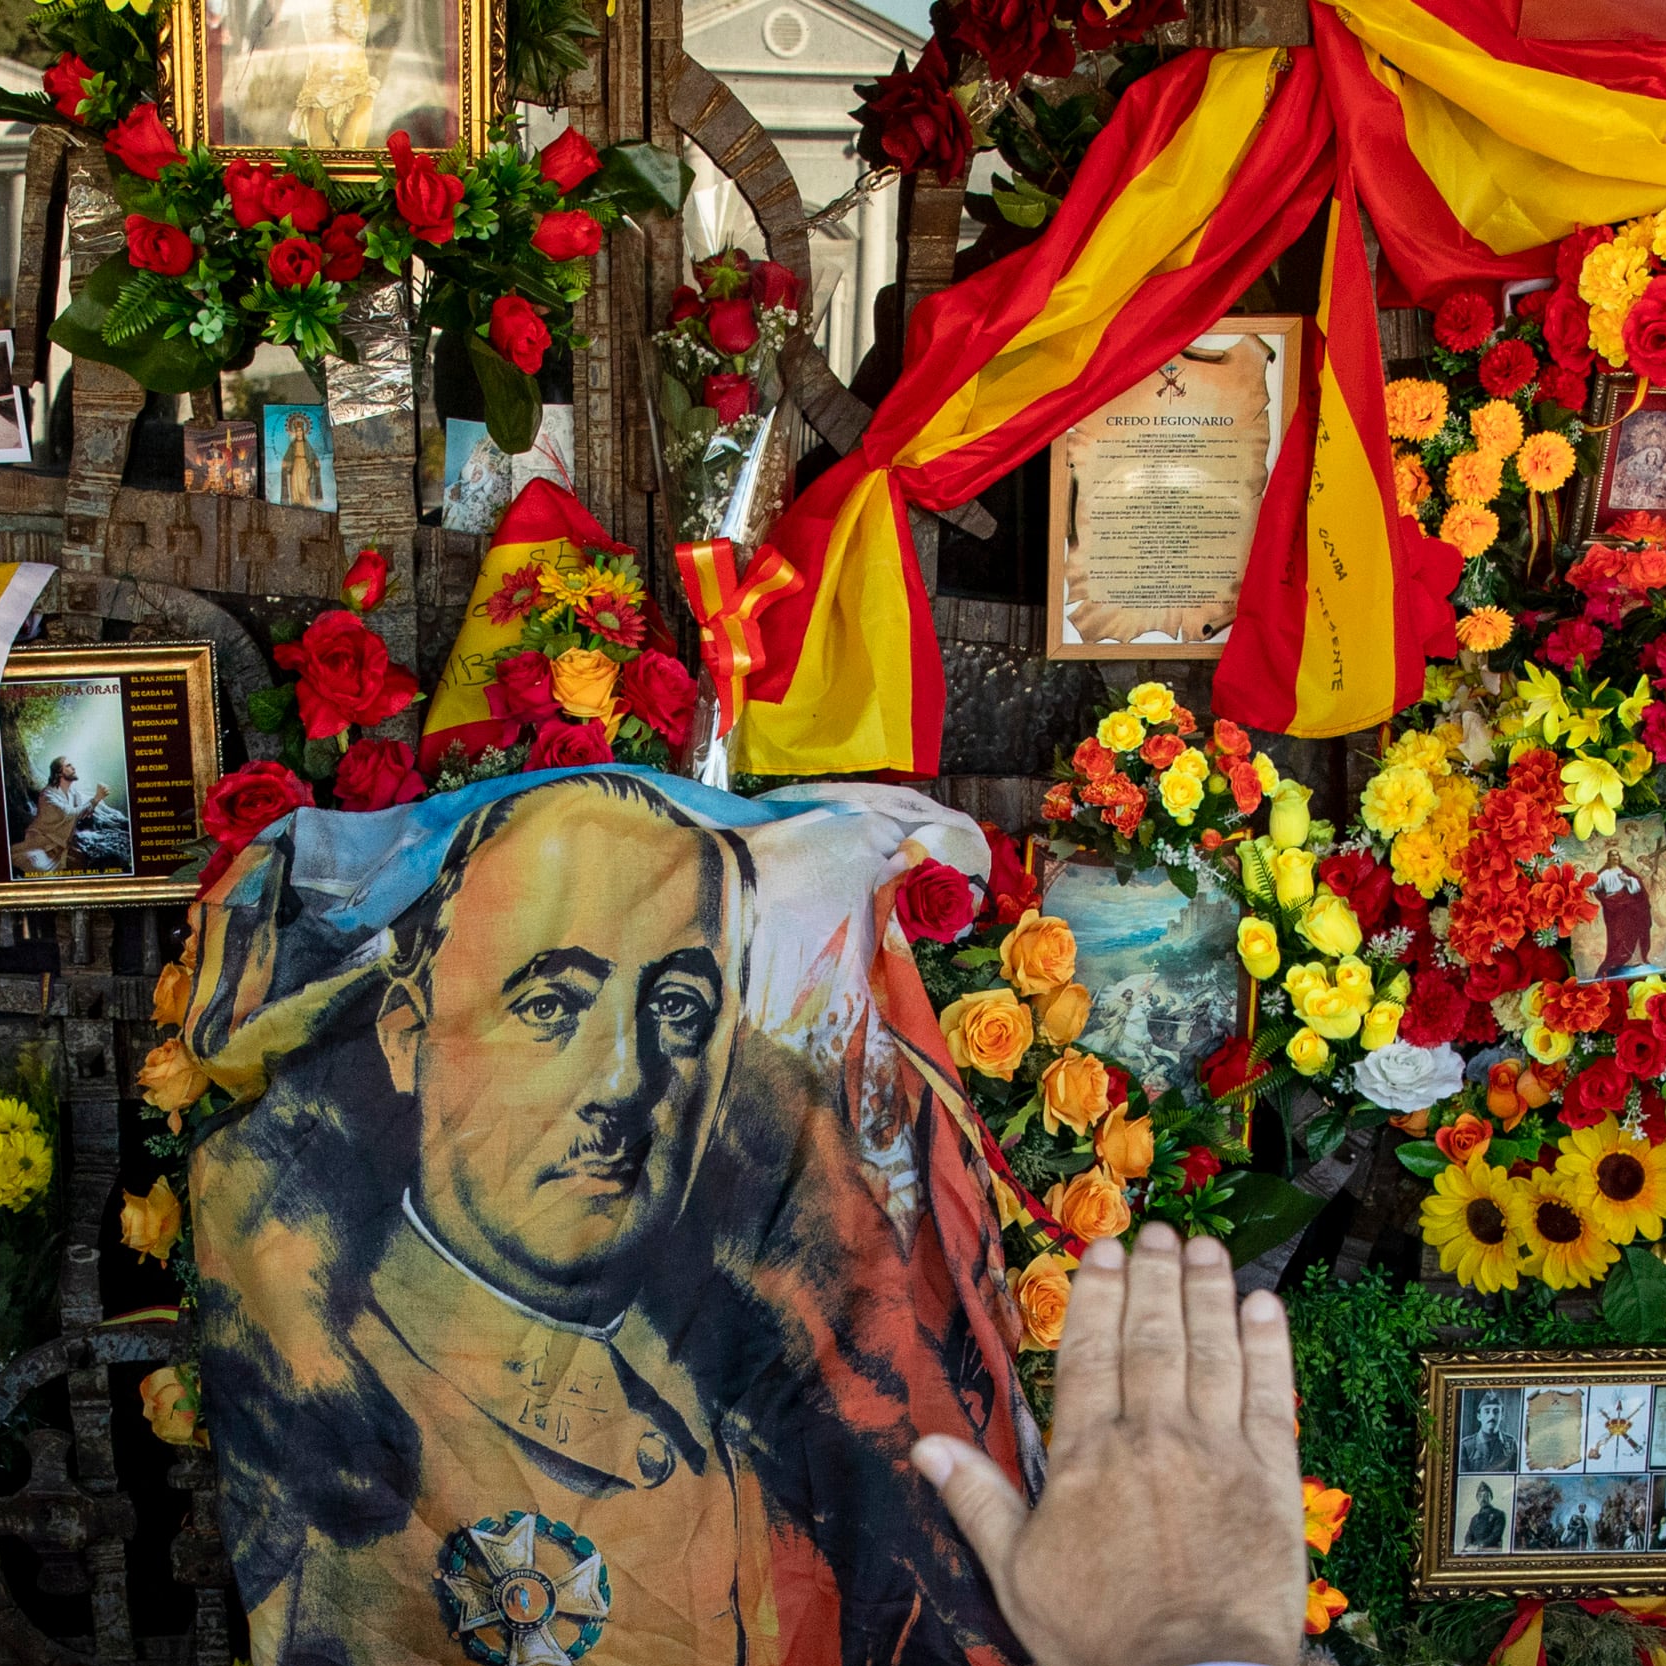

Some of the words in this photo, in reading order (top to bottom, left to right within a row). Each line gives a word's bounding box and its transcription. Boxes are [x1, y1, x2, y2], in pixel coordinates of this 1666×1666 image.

[1106, 416, 1150, 426] CREDO
[1153, 416, 1234, 426] LEGIONARIO
[85, 684, 120, 696] ORAR
[140, 690, 160, 698] CADA
[148, 764, 169, 772] COMO
